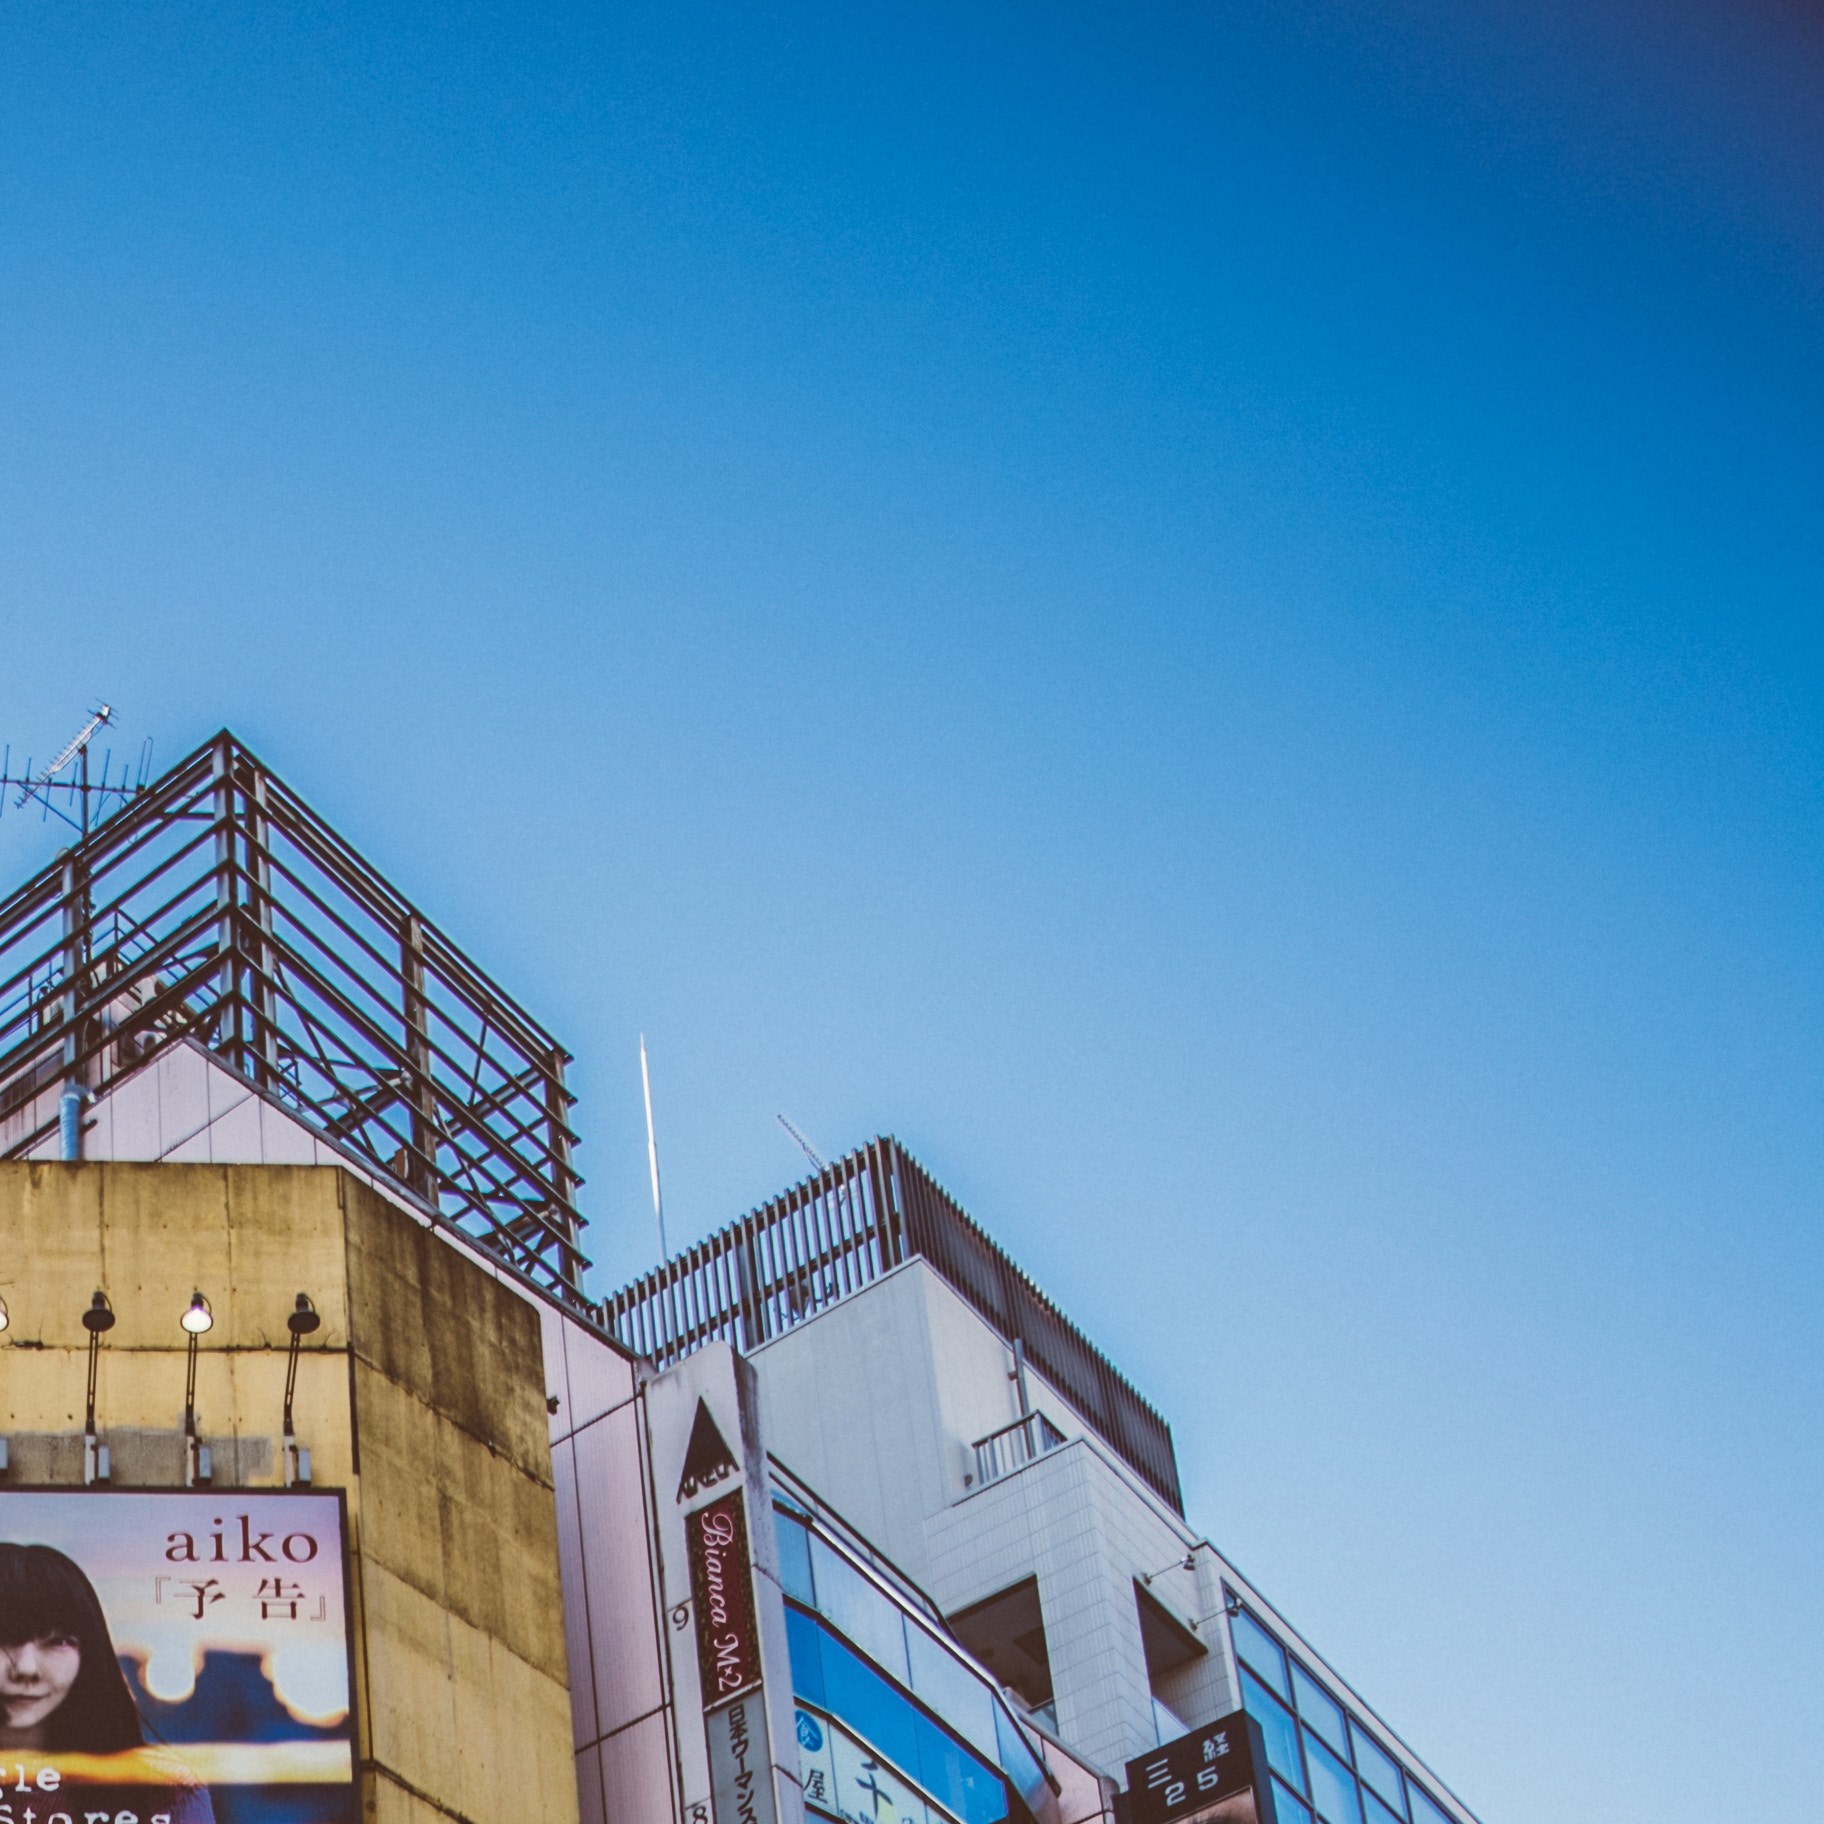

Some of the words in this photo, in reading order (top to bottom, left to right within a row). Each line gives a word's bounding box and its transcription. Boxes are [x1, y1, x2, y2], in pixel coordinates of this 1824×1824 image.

[165, 1515, 319, 1564] aiko
[701, 1511, 739, 1629] Bianca
[154, 1576, 327, 1623] 『予告』
